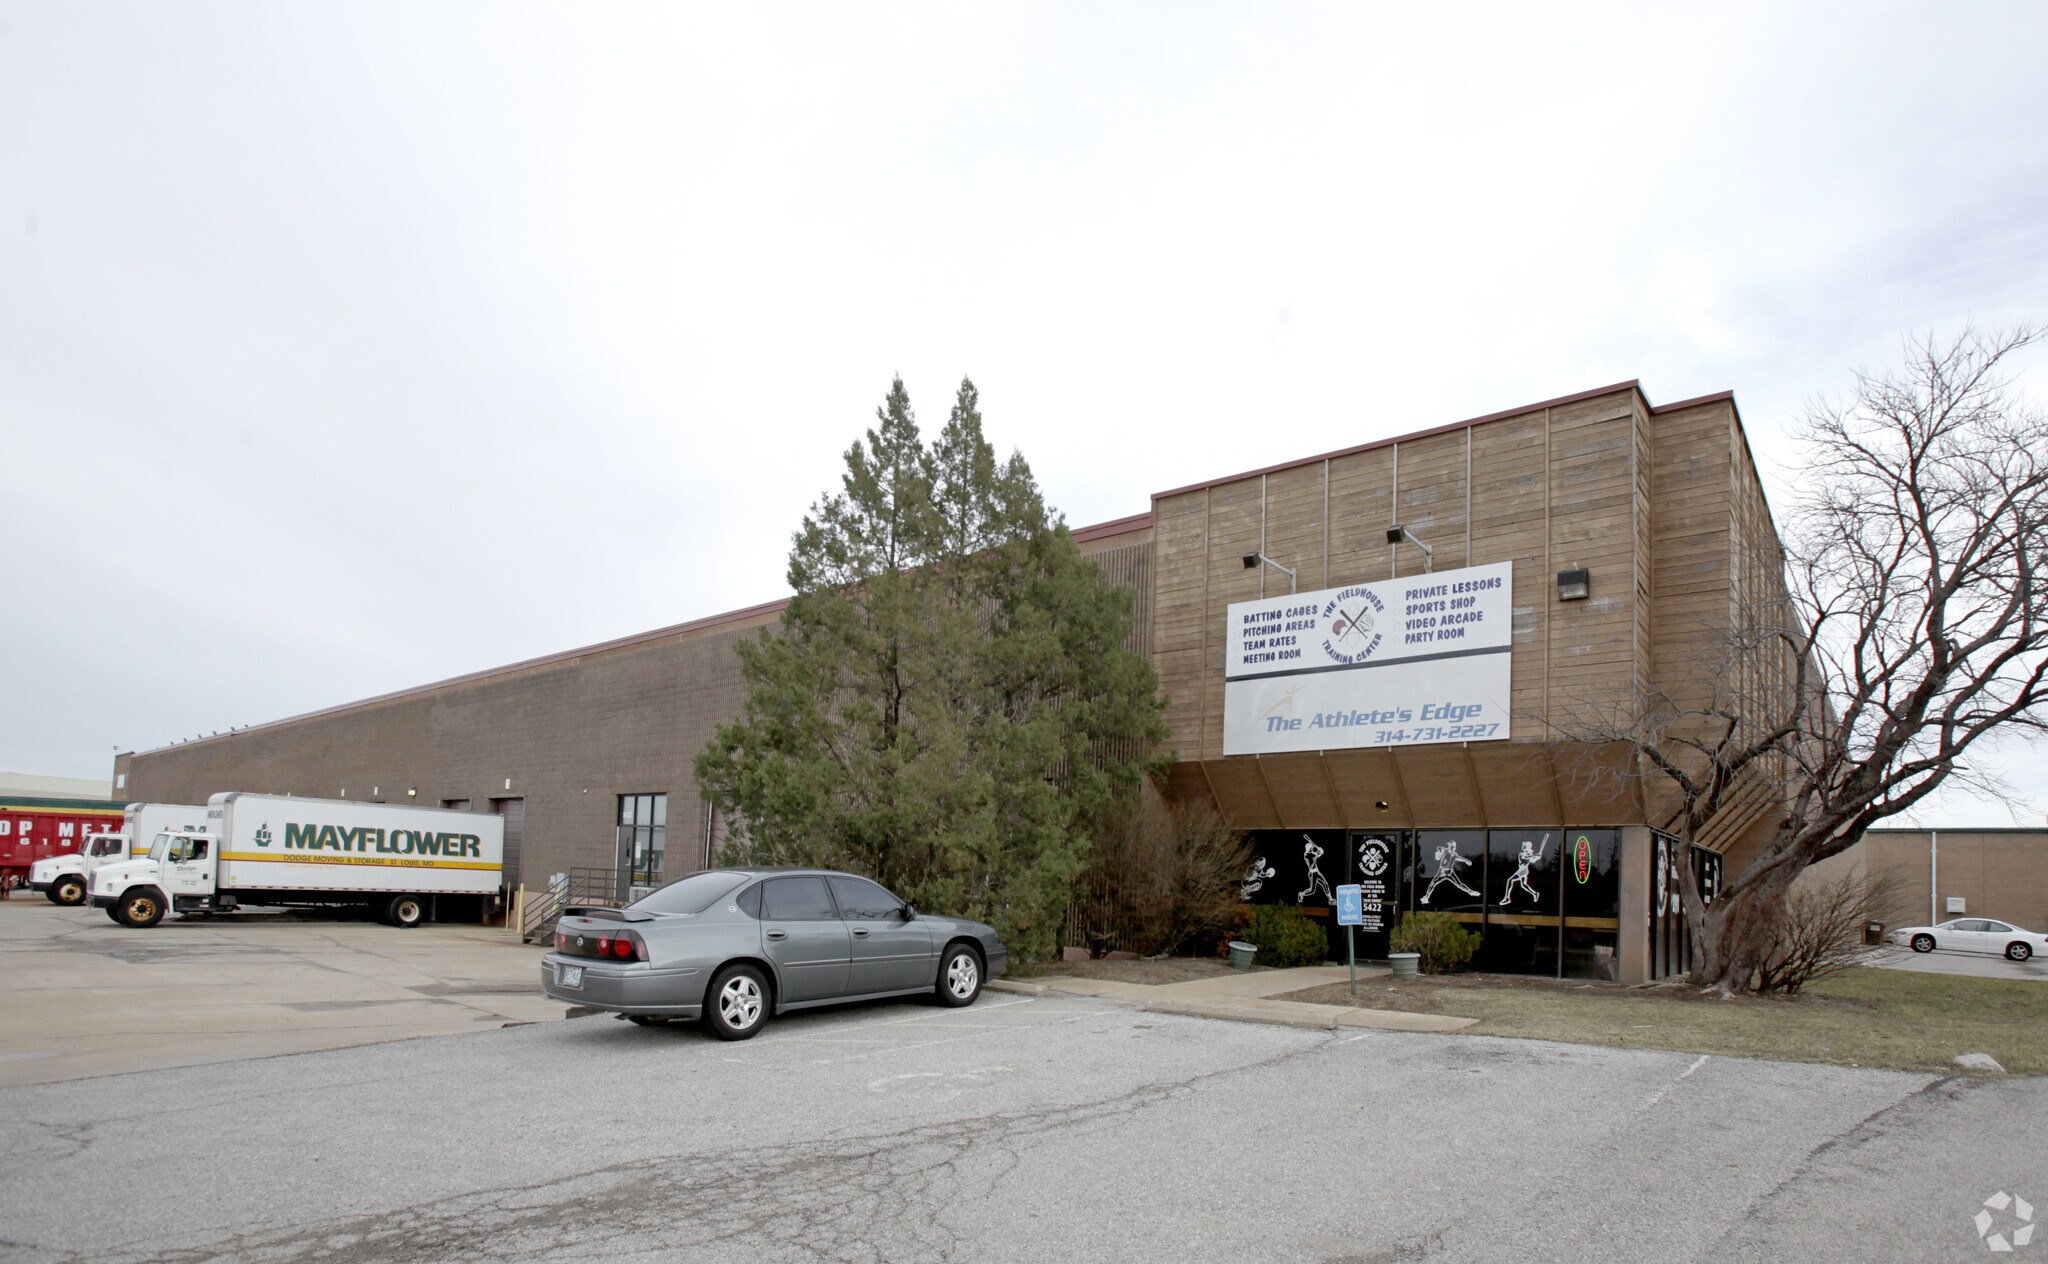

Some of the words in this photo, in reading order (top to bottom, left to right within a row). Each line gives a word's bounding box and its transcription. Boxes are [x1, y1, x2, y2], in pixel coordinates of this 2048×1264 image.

[1405, 585, 1448, 601] PRIVATE
[1452, 577, 1502, 594] LESSONS
[1323, 600, 1337, 618] THE
[1337, 587, 1384, 613] FIELDHOUSE
[1405, 600, 1446, 616] SPORTS
[1450, 596, 1476, 610] SHOP
[1243, 609, 1282, 624] BATTING
[1286, 604, 1318, 618] CAGES
[1405, 617, 1437, 631] VIDEO
[1440, 610, 1483, 627] ARCADE
[1243, 623, 1282, 638] PITCHING
[1285, 618, 1316, 632] AREAS
[1405, 630, 1434, 645] PARTY
[1437, 626, 1465, 641] ROOM
[1243, 639, 1266, 651] TEAM
[1269, 635, 1297, 648] RATES
[1322, 639, 1354, 664] TRAINING
[1356, 633, 1382, 662] CENTER
[1243, 651, 1276, 664] MEETING
[1278, 648, 1301, 660] ROOM
[1266, 715, 1303, 733] The
[1308, 706, 1413, 730] Athlete's
[1420, 702, 1482, 724] Edge
[1373, 723, 1501, 744] 314-731-2227
[284, 822, 481, 858] MAYFLOWER
[284, 854, 311, 862] DODGE
[314, 855, 345, 863] MOVING
[354, 857, 385, 865] STORAGE
[1362, 903, 1382, 912] 5422
